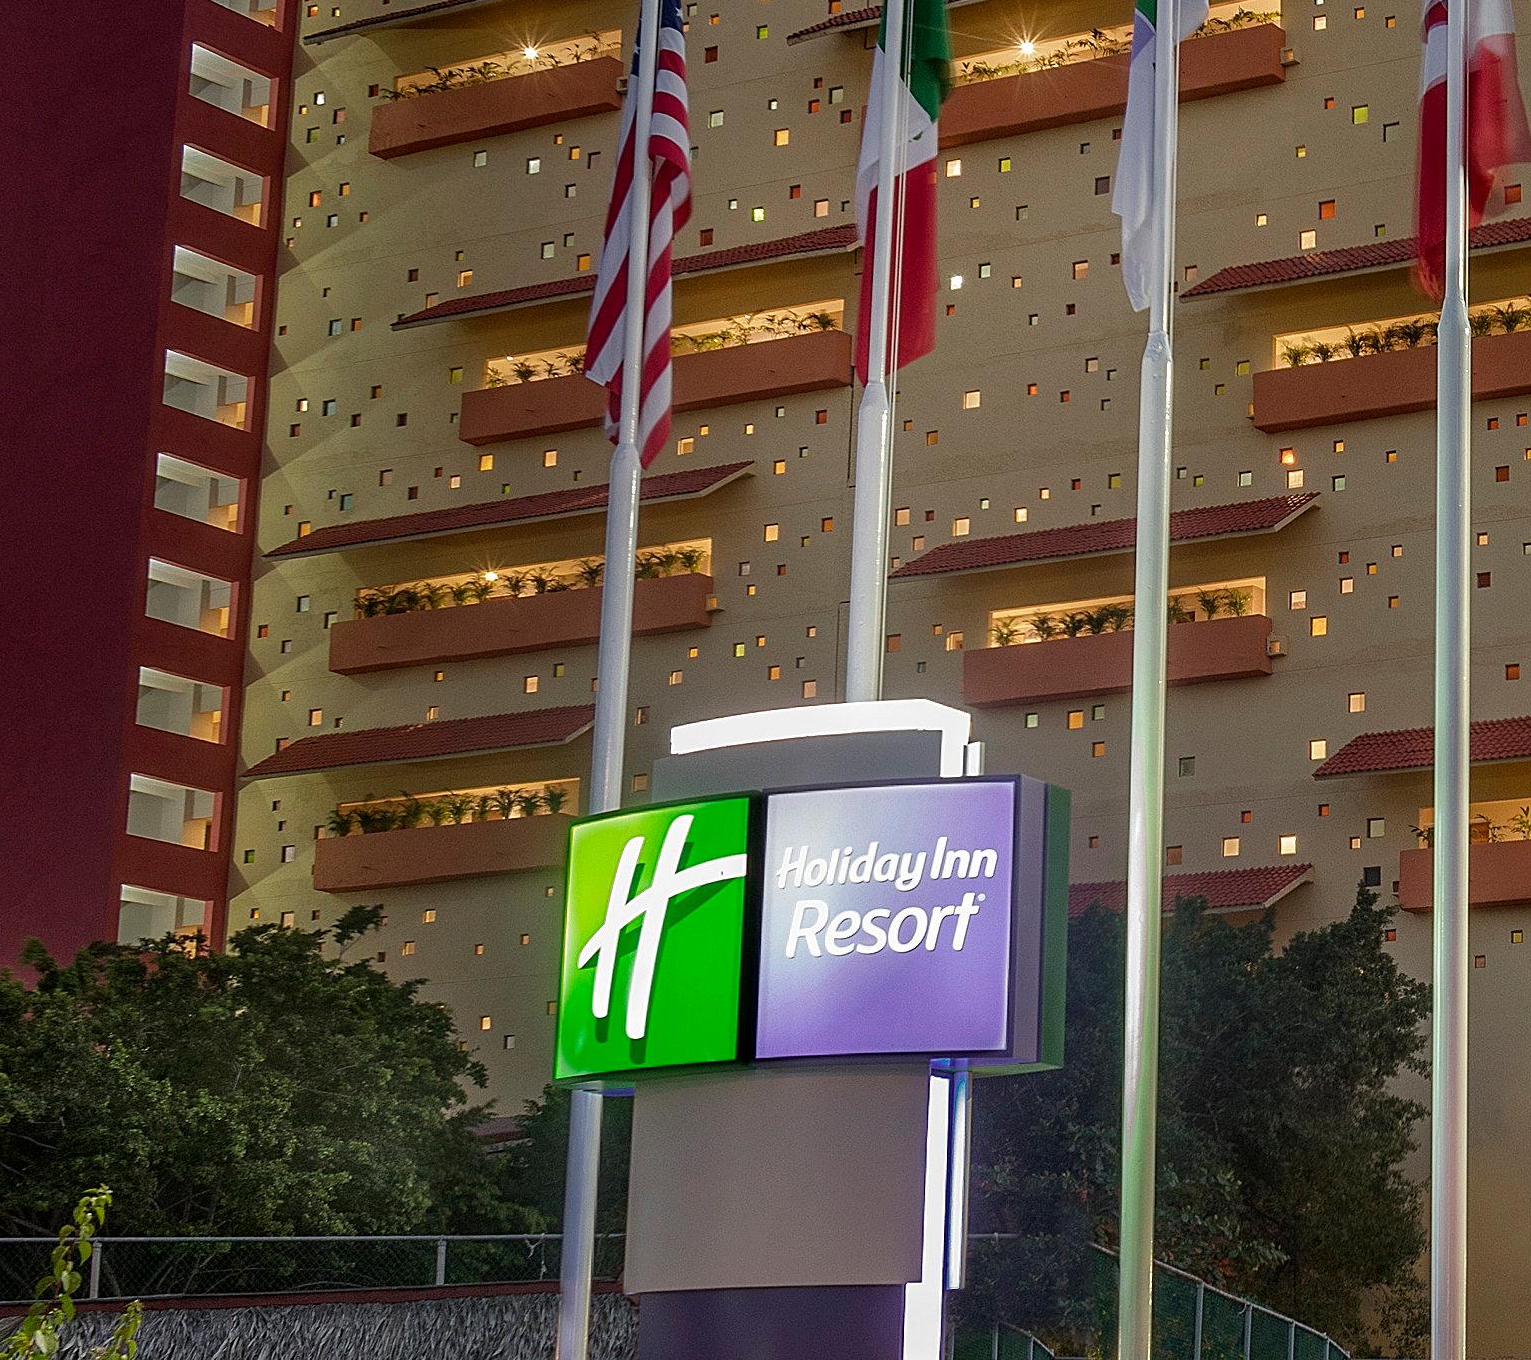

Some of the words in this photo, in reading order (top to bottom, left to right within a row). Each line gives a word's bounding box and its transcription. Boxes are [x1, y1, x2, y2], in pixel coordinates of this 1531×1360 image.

[775, 841, 927, 891] Holiday
[930, 836, 998, 880] Inn
[785, 892, 980, 958] Resort
